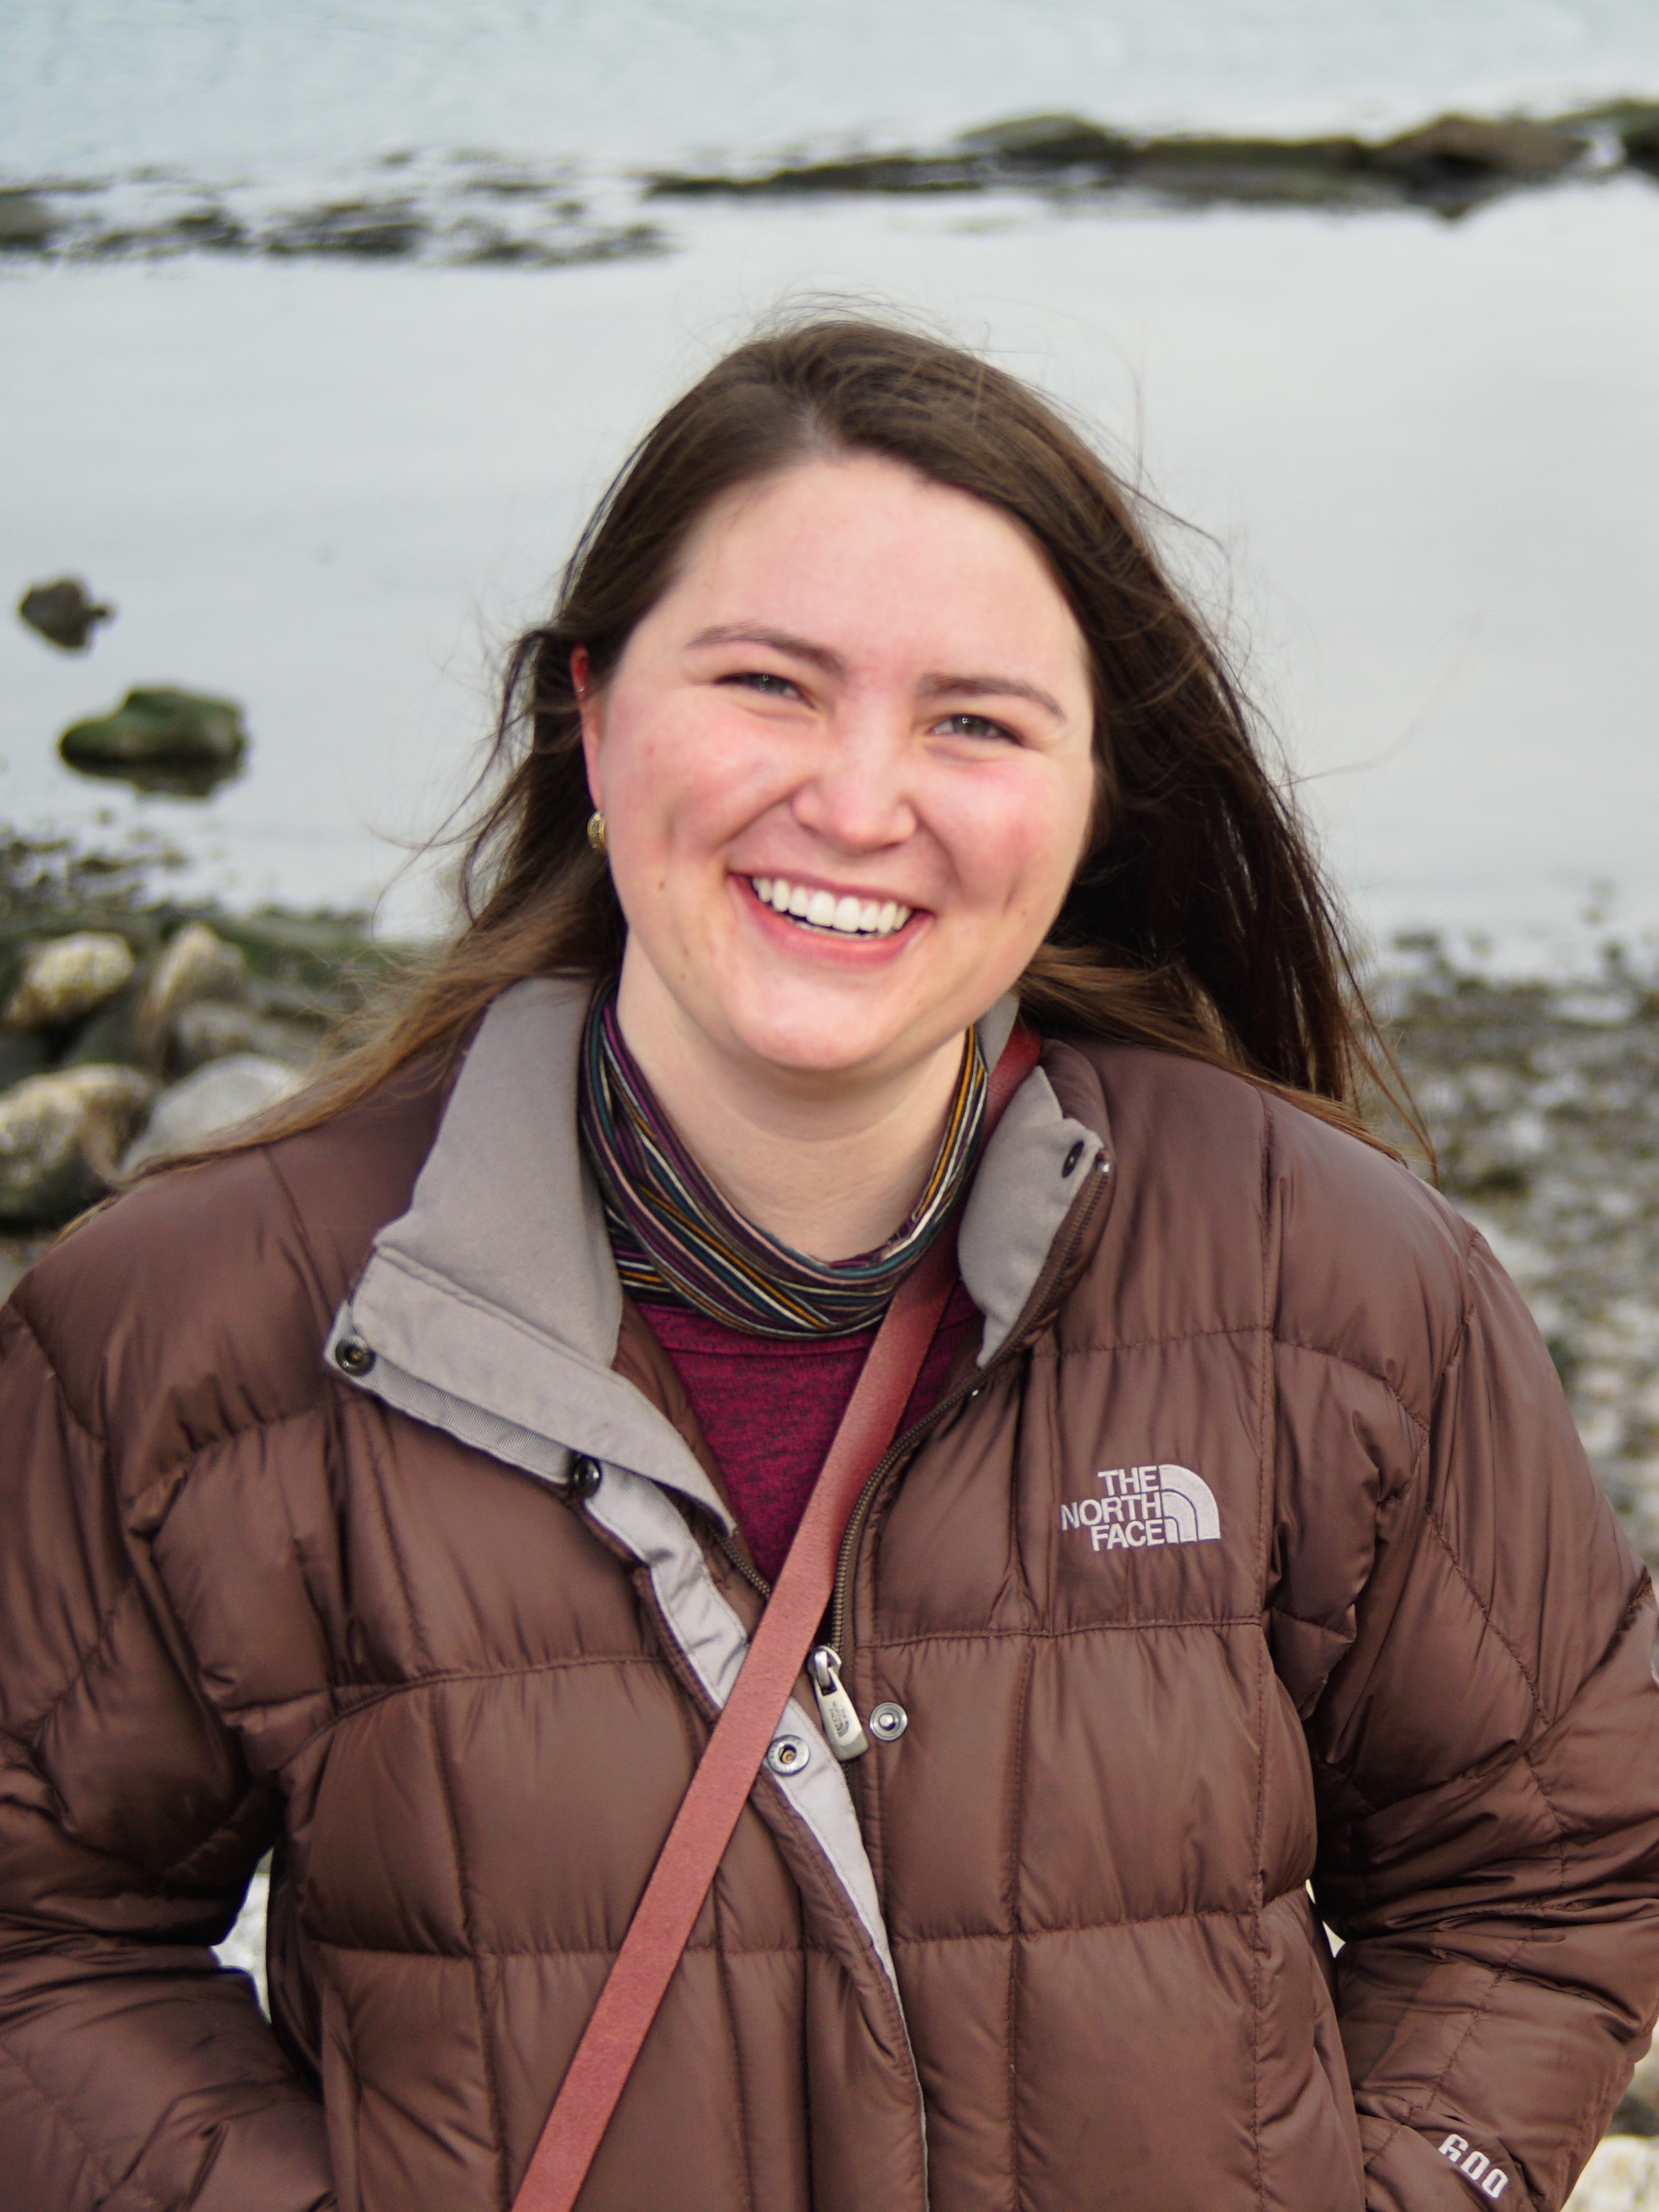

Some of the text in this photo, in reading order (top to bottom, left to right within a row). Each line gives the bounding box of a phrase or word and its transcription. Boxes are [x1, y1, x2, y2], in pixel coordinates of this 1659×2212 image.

[1097, 1466, 1159, 1496] THE
[1060, 1492, 1162, 1531] NORTH
[1090, 1519, 1165, 1552] FACE
[1438, 2133, 1509, 2199] 600
